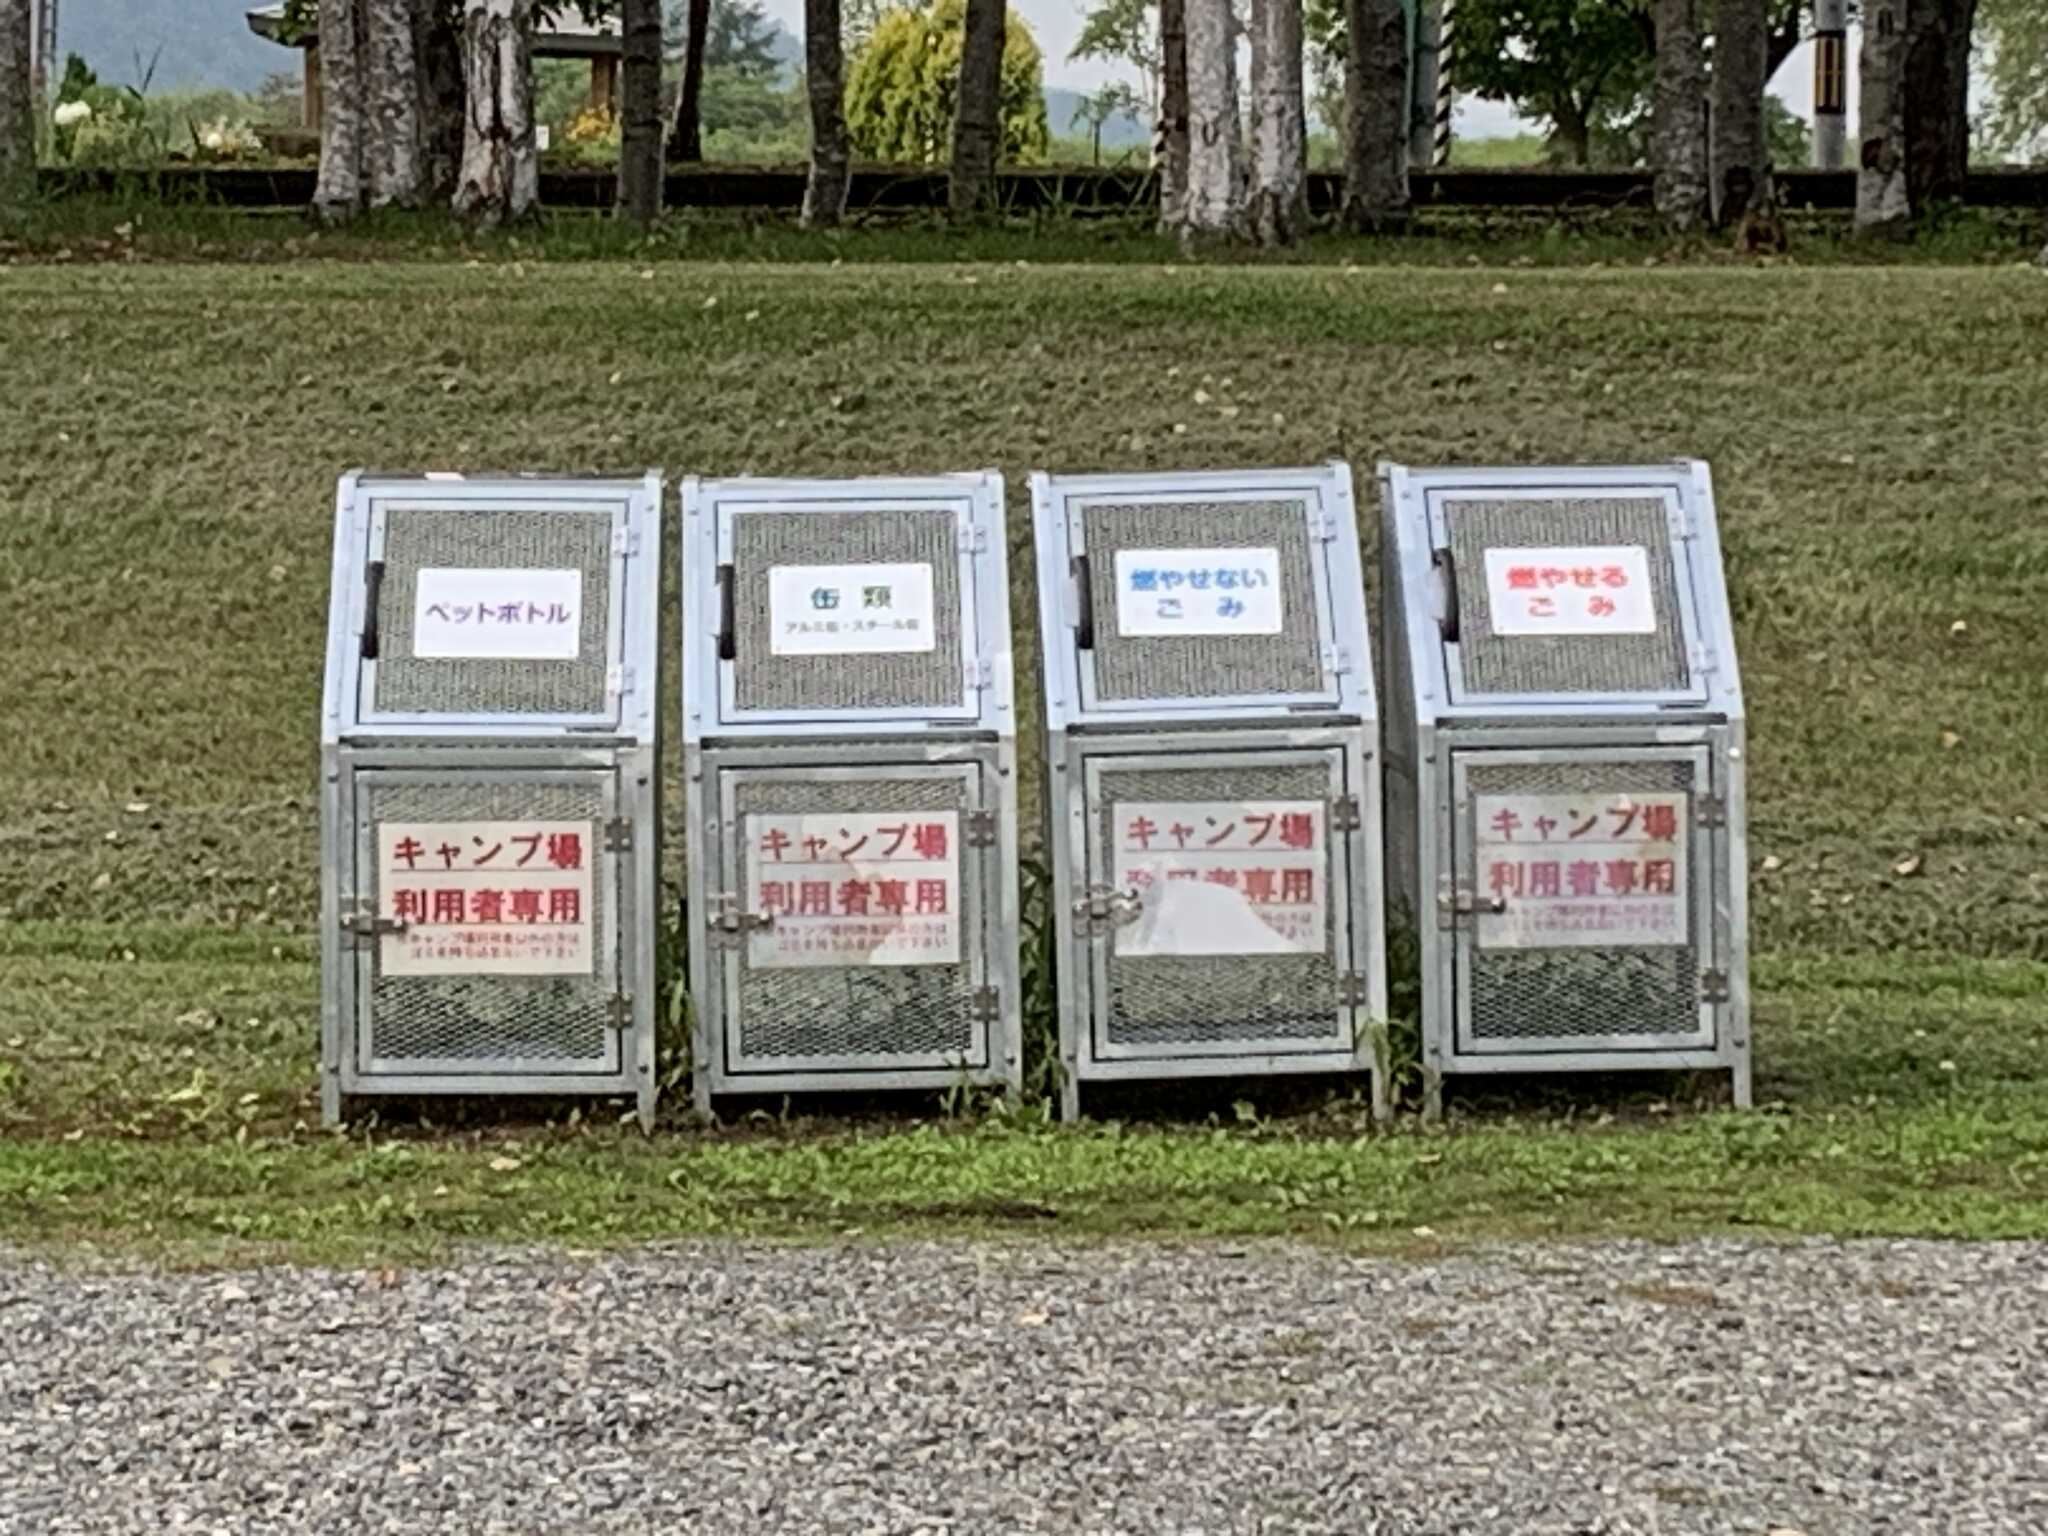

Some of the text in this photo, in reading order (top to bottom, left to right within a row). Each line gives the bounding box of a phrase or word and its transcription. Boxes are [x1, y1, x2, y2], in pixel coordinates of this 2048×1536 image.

[1130, 568, 1269, 591] 燃やせない
[1506, 566, 1628, 589] 燃やせる
[425, 601, 571, 624] ペットボトル
[1127, 813, 1314, 850] キャンプ場
[1490, 804, 1677, 841] キャンプ場
[394, 832, 582, 869] キャンプ場
[760, 824, 947, 860] キャンプ場
[1489, 858, 1675, 897] 利用者専用
[393, 889, 580, 924] 利用者専用
[760, 879, 946, 916] 利用者専用
